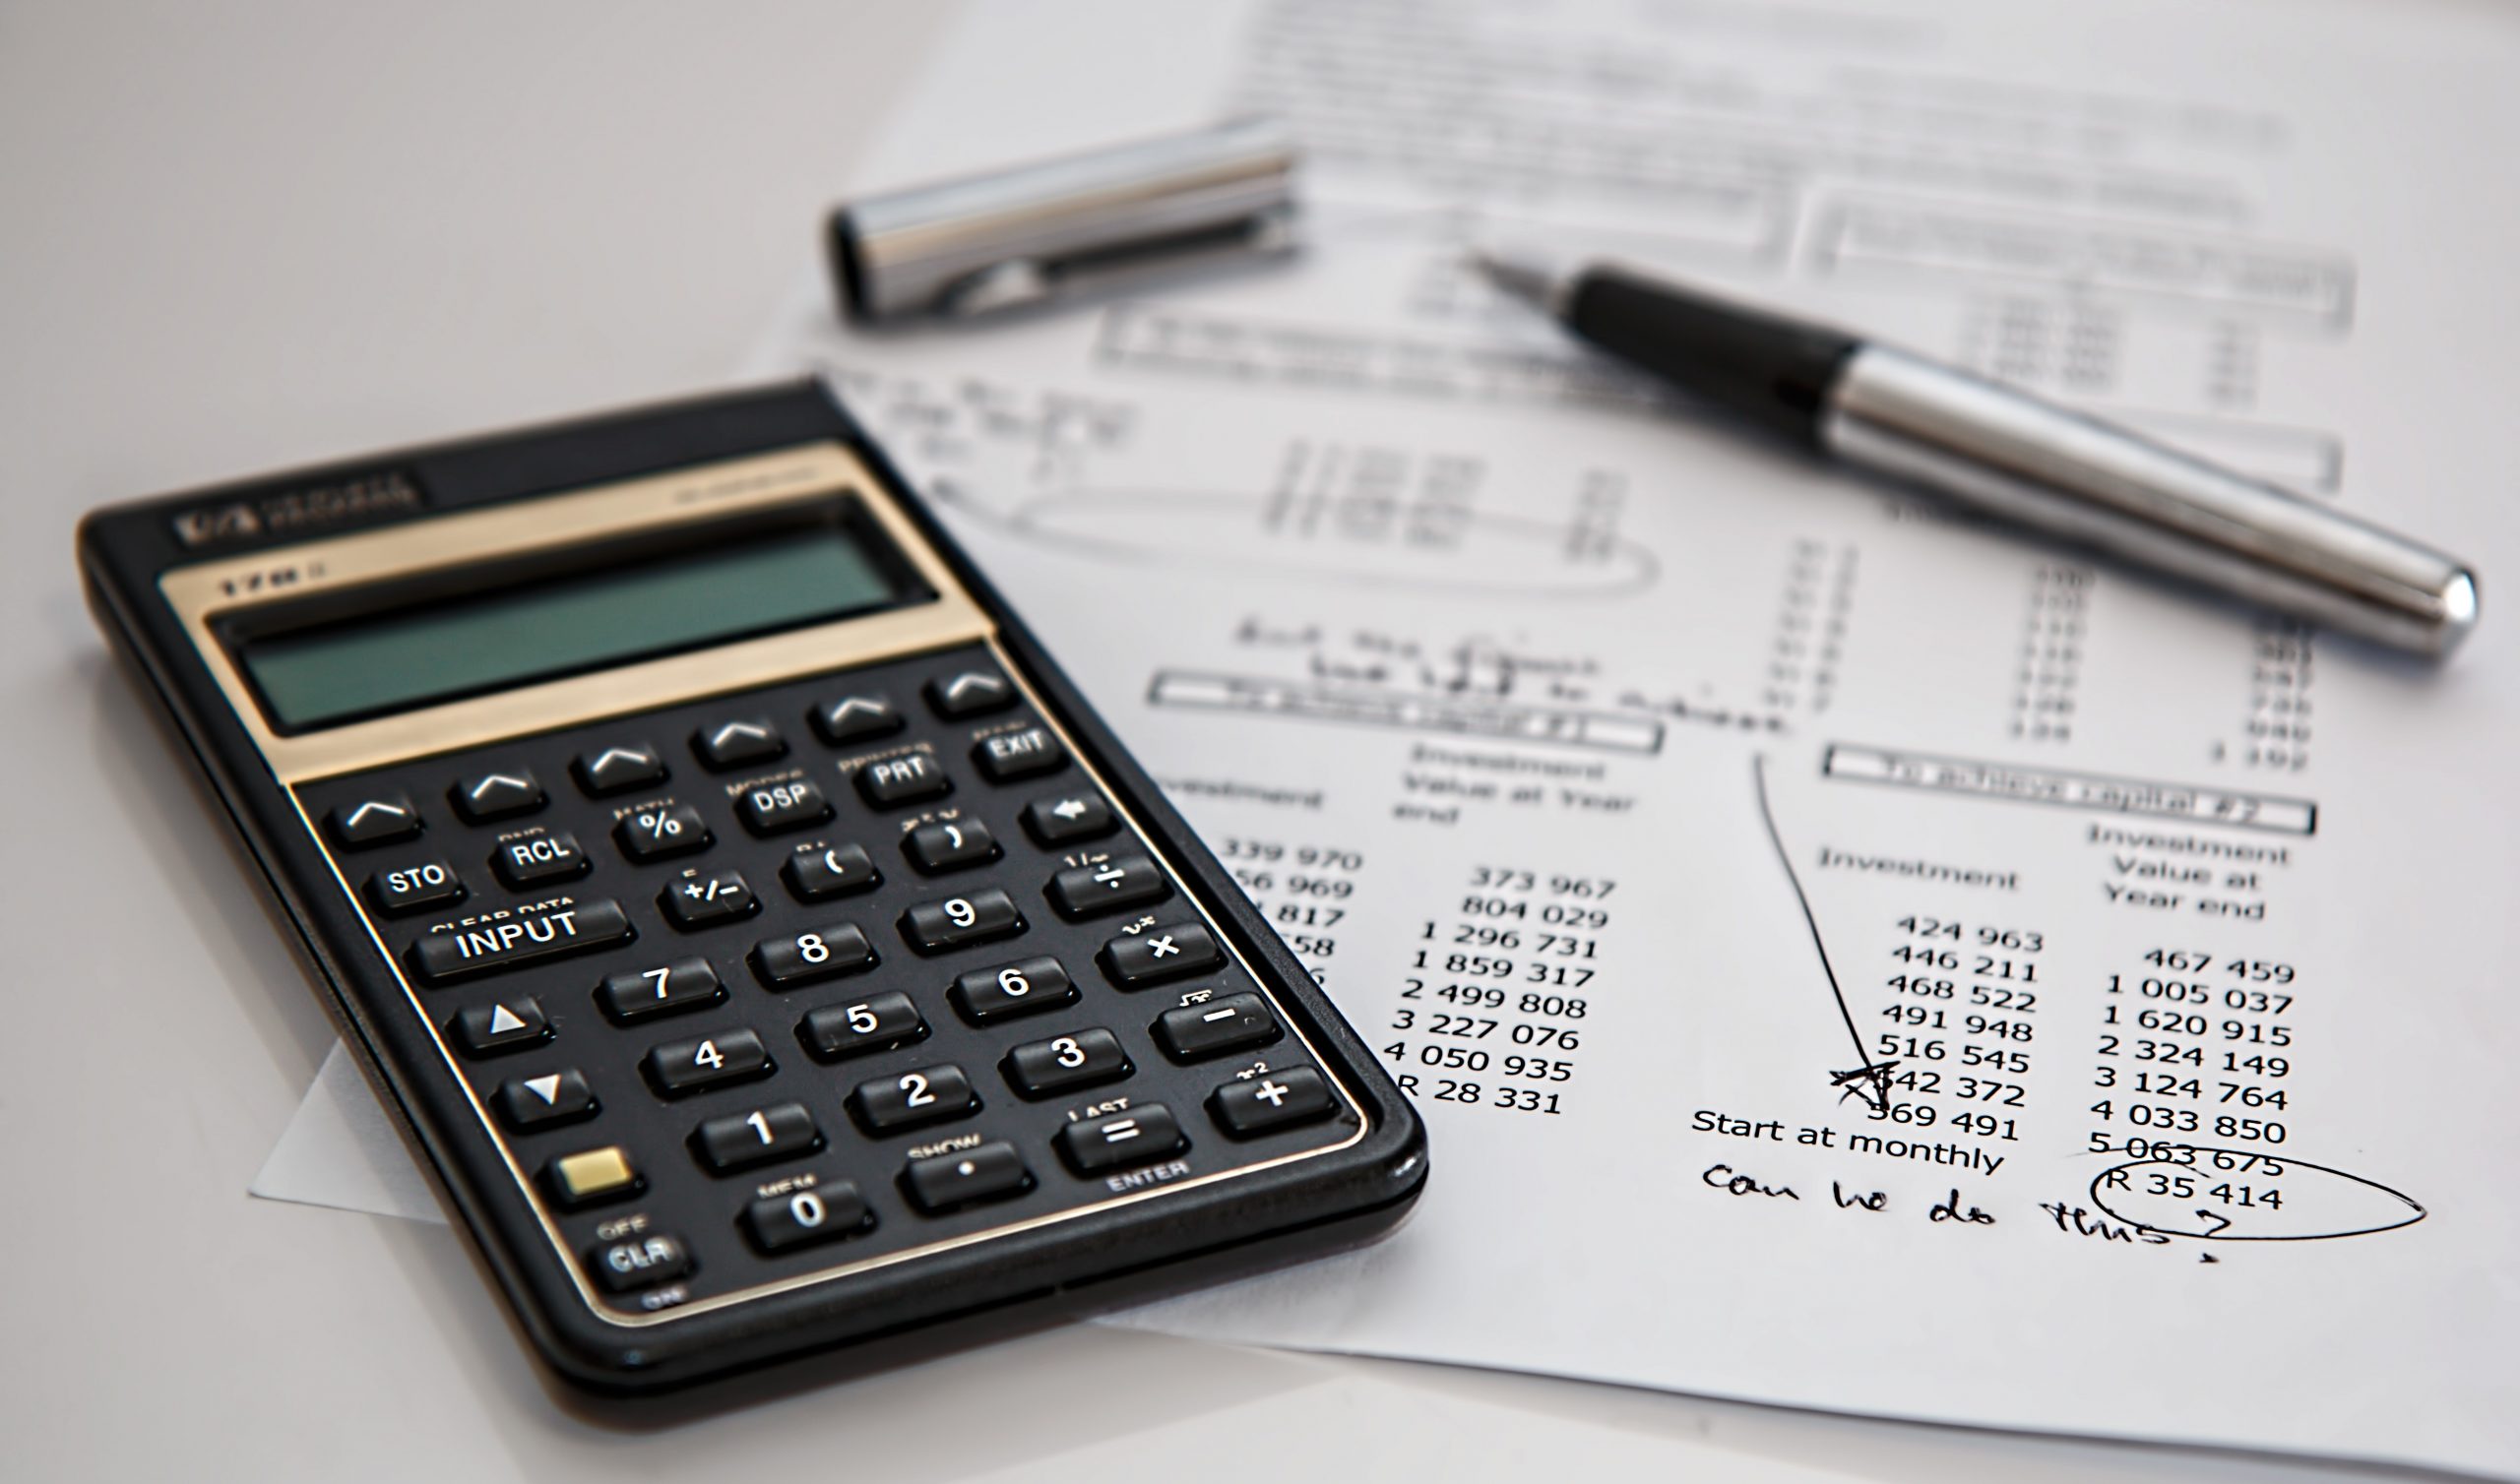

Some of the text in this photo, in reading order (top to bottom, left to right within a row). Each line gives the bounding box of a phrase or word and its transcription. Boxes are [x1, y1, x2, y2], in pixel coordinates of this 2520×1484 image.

[987, 730, 1044, 759] EXIT
[872, 756, 925, 785] PRT
[753, 783, 806, 812] DSP
[511, 837, 571, 866] RCL
[1222, 836, 1364, 872] 339 970
[2088, 824, 2289, 866] Investment
[388, 865, 446, 894] STO
[1475, 867, 1616, 899] 373 967
[1816, 846, 2021, 891] Investment
[2112, 855, 2260, 892] Value at
[1287, 874, 1354, 900] 969
[2104, 882, 2267, 922] Year end
[944, 897, 976, 929] 9
[1276, 902, 1346, 929] 817
[1462, 897, 1609, 929] 804 029
[456, 911, 577, 958] INPUT
[797, 933, 830, 964] 8
[1421, 921, 1597, 959] 1 296 731
[1897, 916, 2044, 953] 424 963
[1413, 950, 1596, 988] 1 859 317
[1892, 945, 2037, 983] 446 211
[2144, 949, 2296, 985] 467 459
[642, 967, 669, 1000] 7
[997, 967, 1030, 998] 6
[1401, 978, 1588, 1020] 2 499 808
[1886, 974, 2037, 1014] 468 522
[2108, 974, 2294, 1016] 1 005 037
[847, 1004, 878, 1035] 5
[1391, 1009, 1580, 1051] 3 227 076
[1881, 1004, 2034, 1043] 491 948
[2104, 1005, 2292, 1048] 1 620 915
[694, 1039, 724, 1071] 4
[1050, 1036, 1086, 1068] 3
[1382, 1041, 1574, 1082] 4 050 935
[1877, 1033, 2031, 1075] 516 545
[2097, 1034, 2290, 1079] 2 324 149
[899, 1073, 936, 1108] 2
[1398, 1075, 1562, 1115] R 28 331
[1955, 1076, 2026, 1108] 372
[2094, 1066, 2289, 1111] 3 124 764
[746, 1110, 775, 1145] 1
[1950, 1111, 2019, 1142] 491
[2090, 1099, 2287, 1144] 4 033 850
[1691, 1109, 2005, 1177] Start at monthly
[2088, 1132, 2285, 1177] 5 063 675
[1105, 1161, 1192, 1193] ENTER
[2106, 1168, 2284, 1210] R 35 414
[790, 1192, 825, 1228] 0
[1928, 1188, 1996, 1226] do
[598, 1212, 650, 1241] OFF
[608, 1236, 674, 1272] CLR
